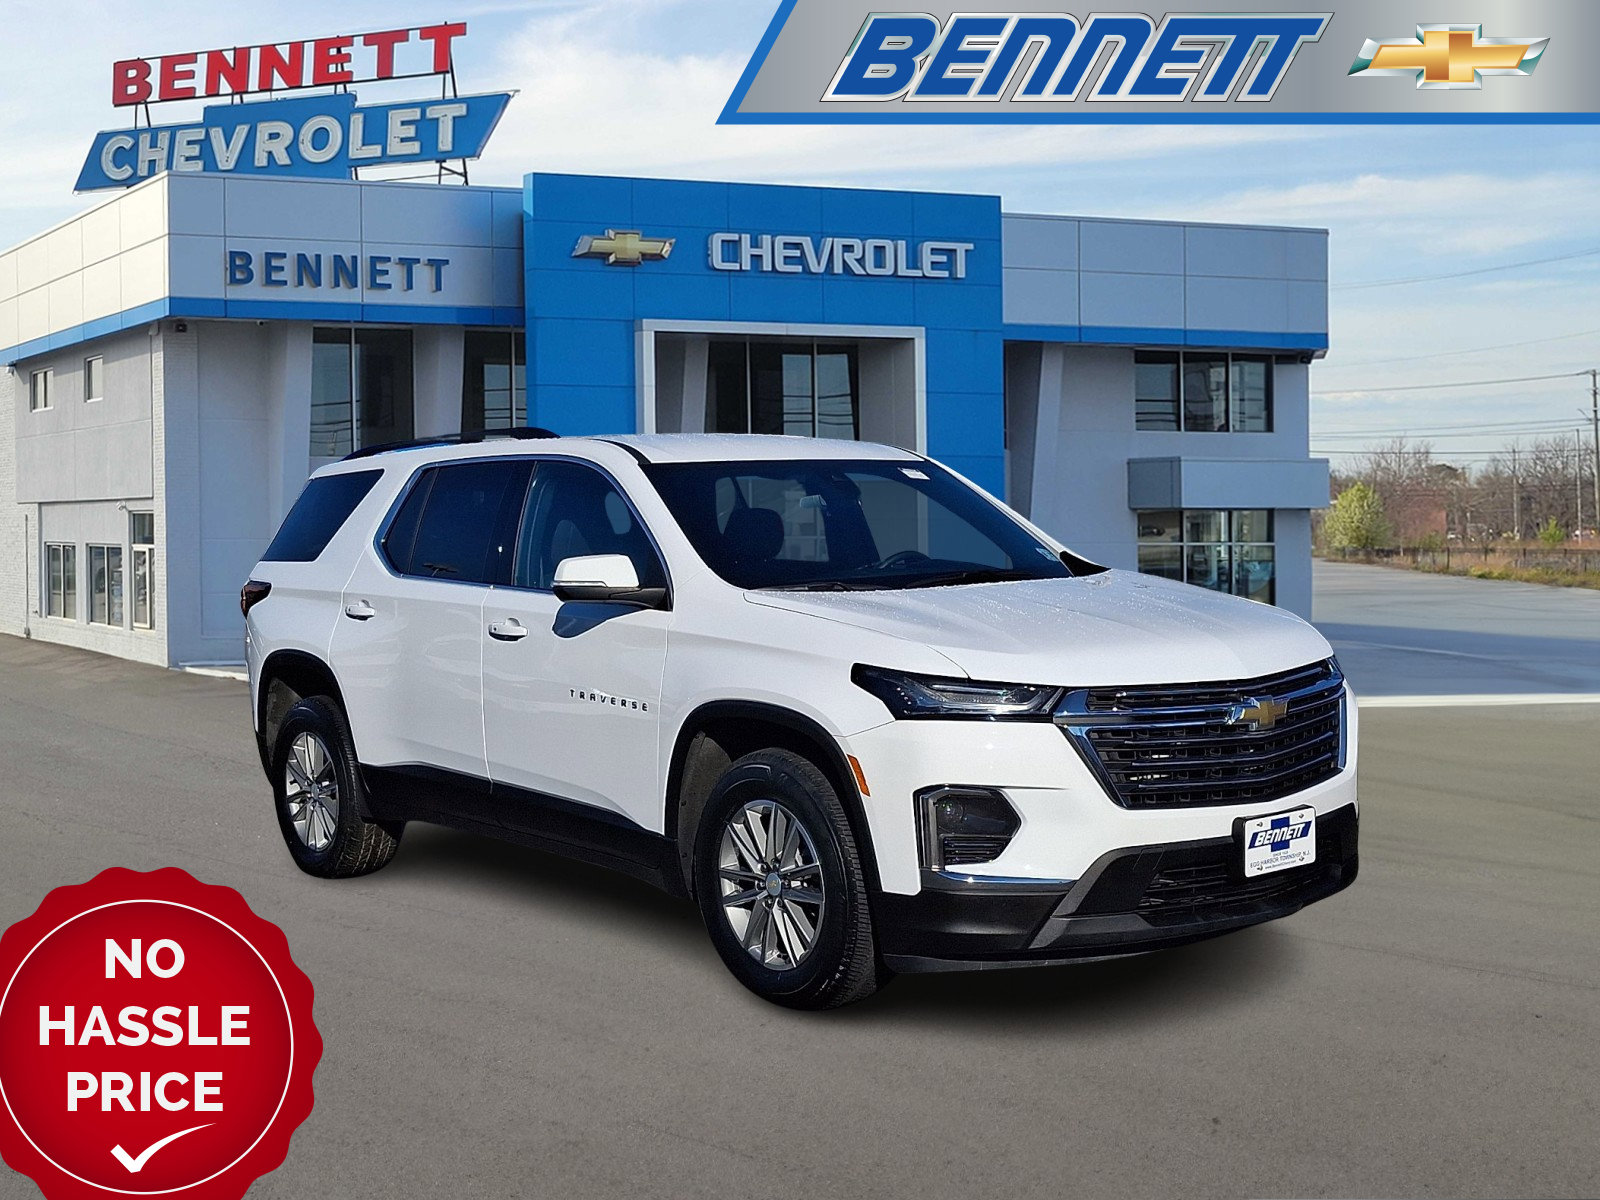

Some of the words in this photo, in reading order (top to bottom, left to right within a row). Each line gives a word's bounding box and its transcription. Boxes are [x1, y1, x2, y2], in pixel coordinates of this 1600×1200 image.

[112, 22, 467, 106] BENNETT
[100, 102, 468, 181] CHEVROLET
[226, 250, 450, 293] BENNETT
[708, 232, 975, 279] CHEVROLET
[570, 689, 648, 712] TRAVERSE
[1254, 823, 1306, 847] BENNETT
